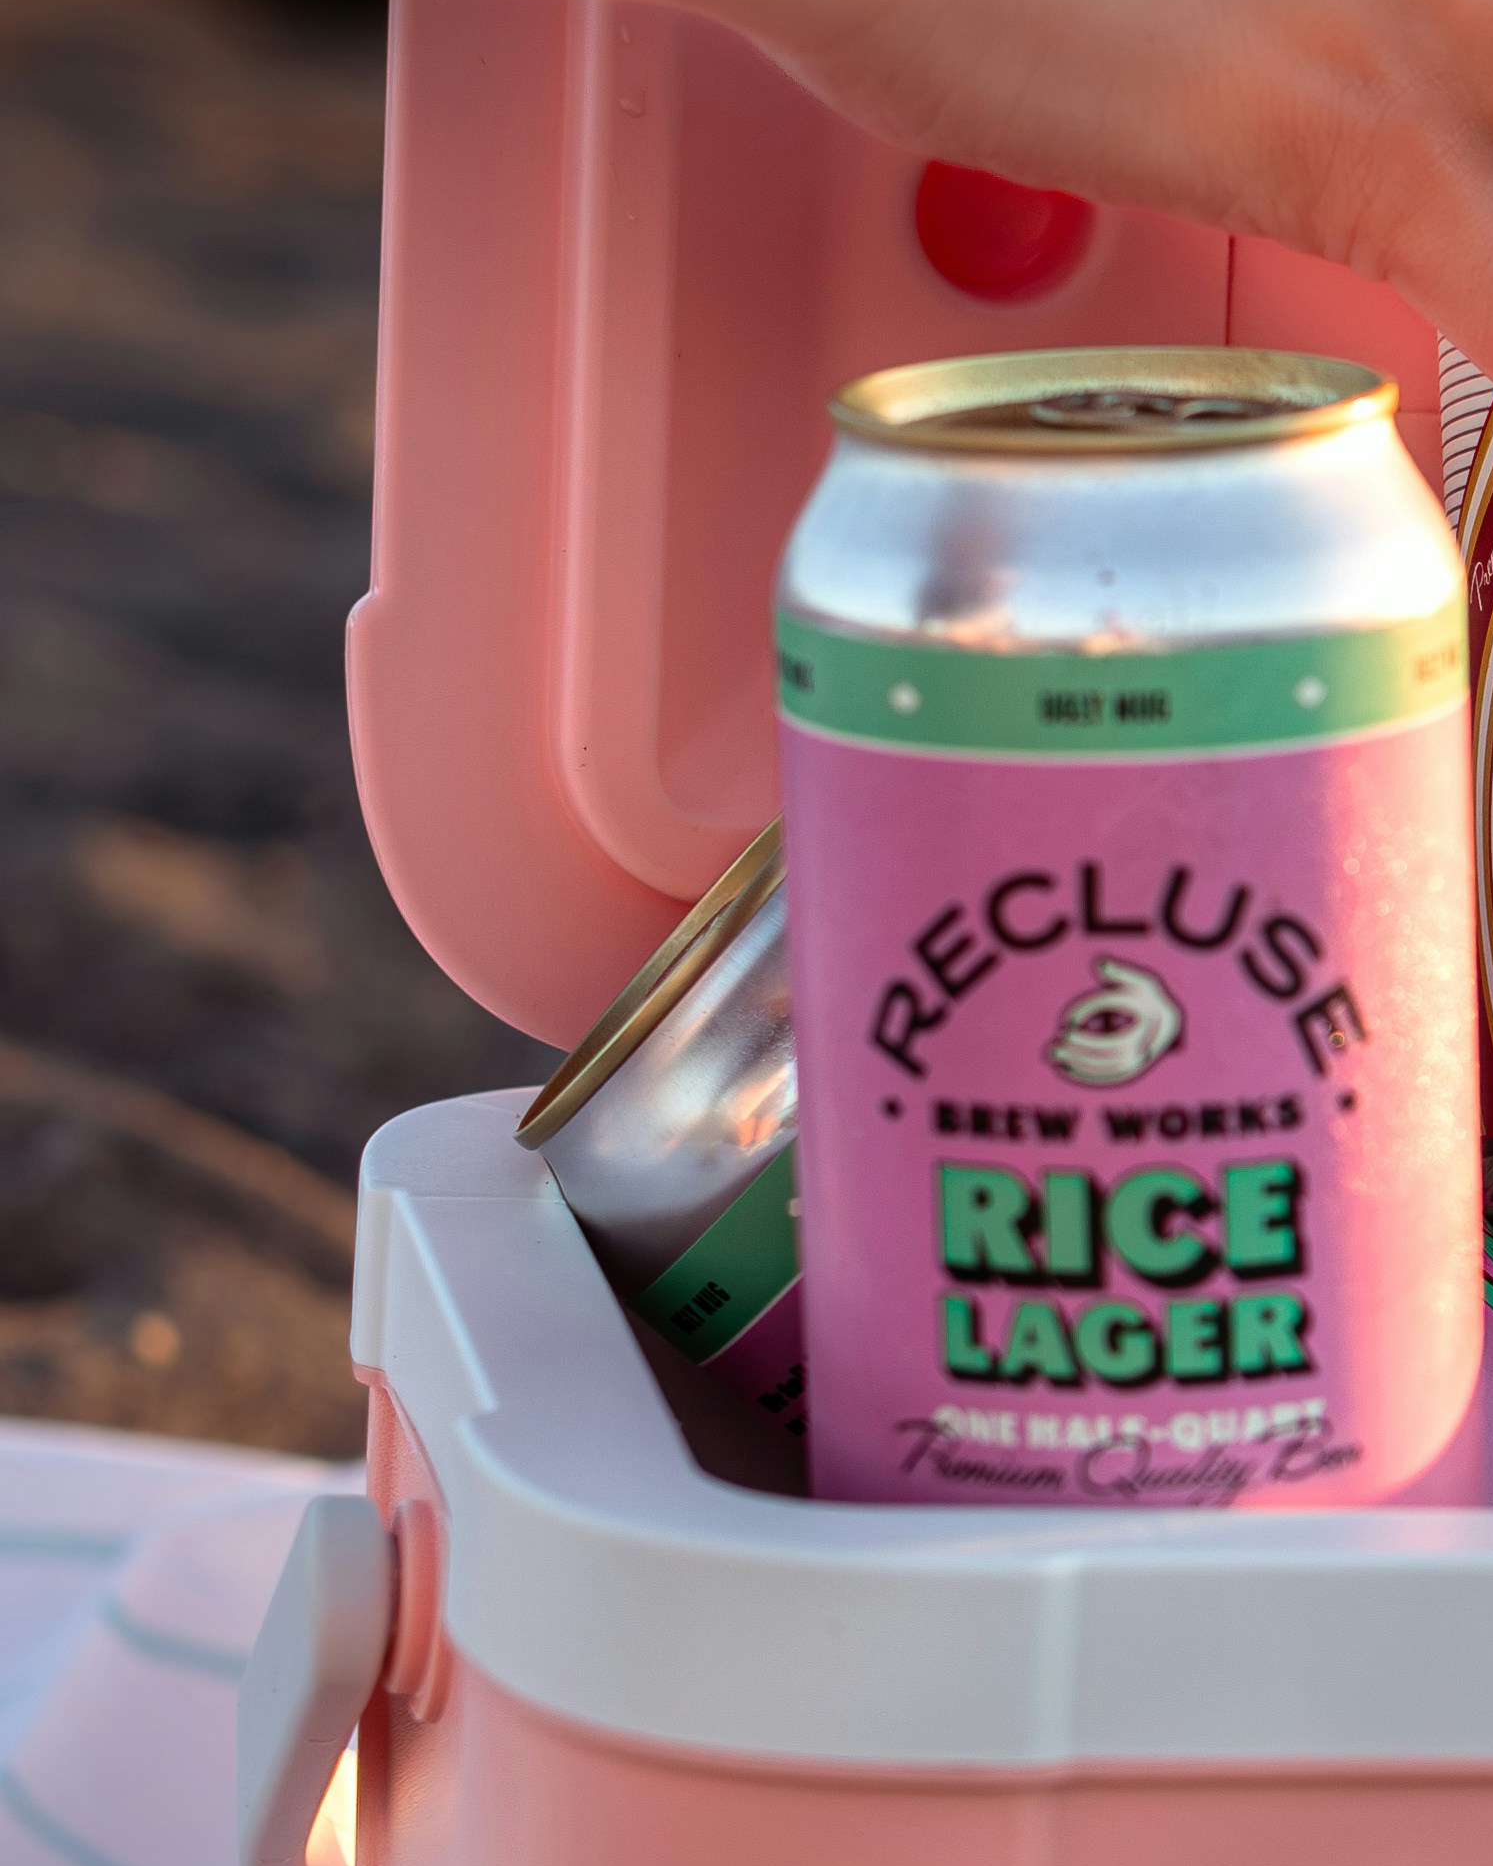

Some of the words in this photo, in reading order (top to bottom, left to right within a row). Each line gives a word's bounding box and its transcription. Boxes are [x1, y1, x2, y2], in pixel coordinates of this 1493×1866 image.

[871, 859, 1368, 1081] RECLUSE
[934, 1100, 1078, 1143] BREW
[1105, 1096, 1301, 1145] WORKS
[938, 1155, 1306, 1290] RICE
[939, 1290, 1318, 1388] LAGER
[896, 1417, 1066, 1491] Premium
[1074, 1433, 1255, 1507] Quality
